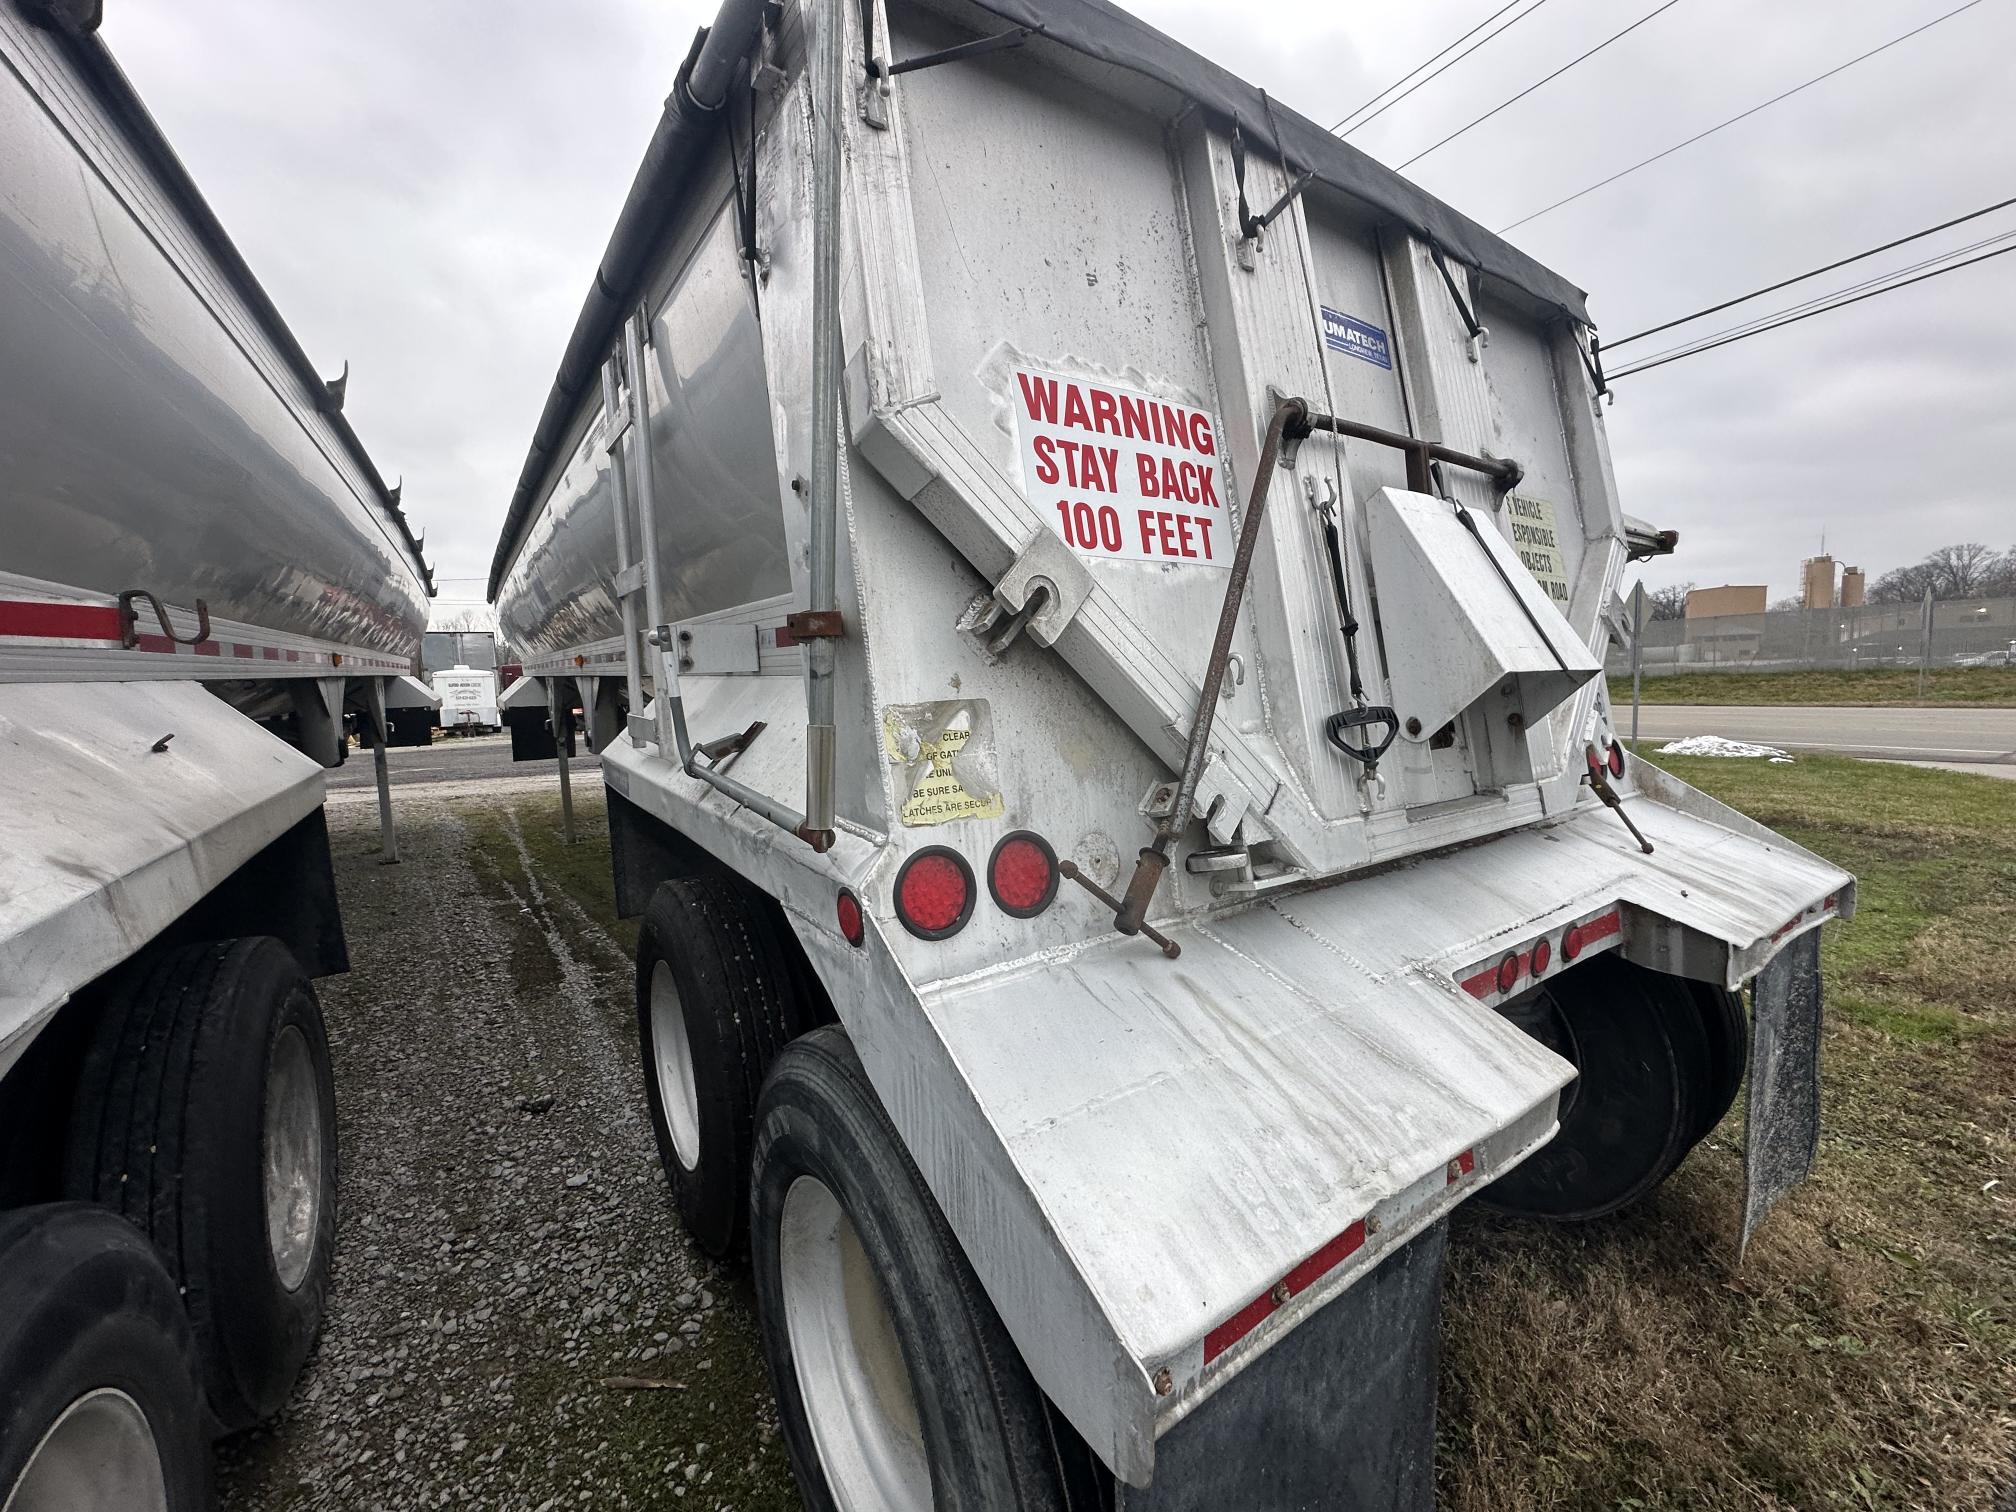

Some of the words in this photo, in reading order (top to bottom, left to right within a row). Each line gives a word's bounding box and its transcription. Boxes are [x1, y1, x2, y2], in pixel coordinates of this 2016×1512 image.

[1017, 372, 1216, 456] WARNING
[1033, 435, 1119, 493] STAY
[1136, 453, 1220, 508] BACK
[1512, 496, 1543, 520] VEHICLE
[1056, 500, 1123, 552] 100
[1138, 509, 1213, 560] FEET
[1520, 550, 1553, 573] OBJECTS
[1551, 581, 1568, 601] ROAD
[926, 752, 938, 761] OF
[940, 750, 959, 760] GAT
[913, 789, 925, 798] BE
[927, 787, 950, 796] SURE
[903, 805, 942, 818] LATCHES
[945, 802, 962, 813] ARE
